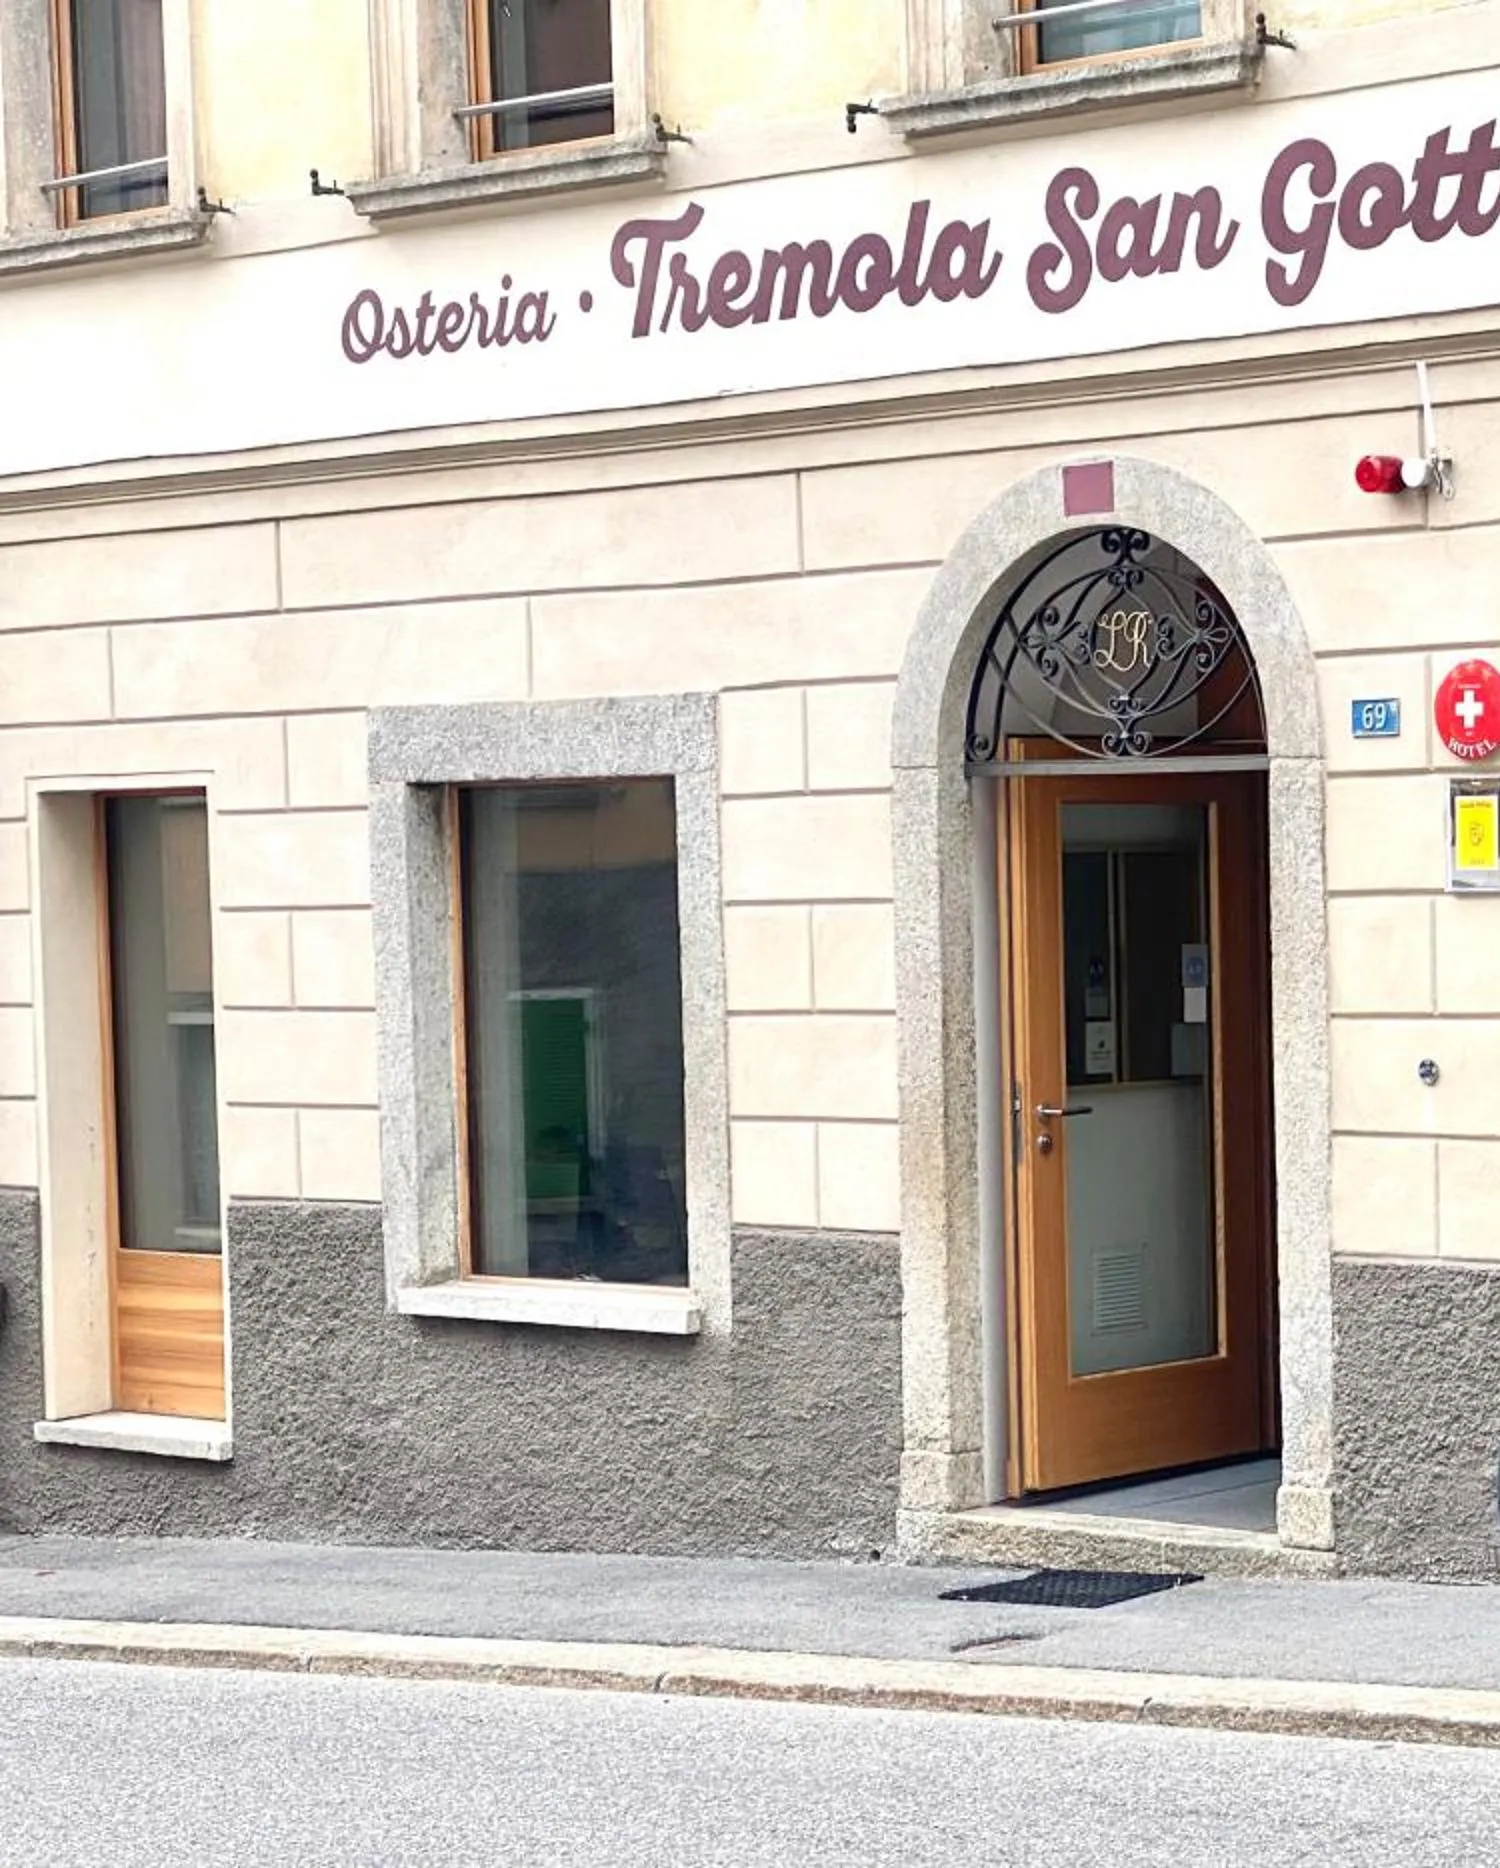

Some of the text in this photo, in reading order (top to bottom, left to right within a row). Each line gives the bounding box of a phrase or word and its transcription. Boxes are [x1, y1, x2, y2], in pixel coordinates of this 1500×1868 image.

[341, 274, 556, 365] Osteria
[611, 202, 1002, 338] Tremola
[1026, 167, 1240, 314] San
[1361, 702, 1388, 729] 69
[1447, 736, 1498, 758] HOTEL
